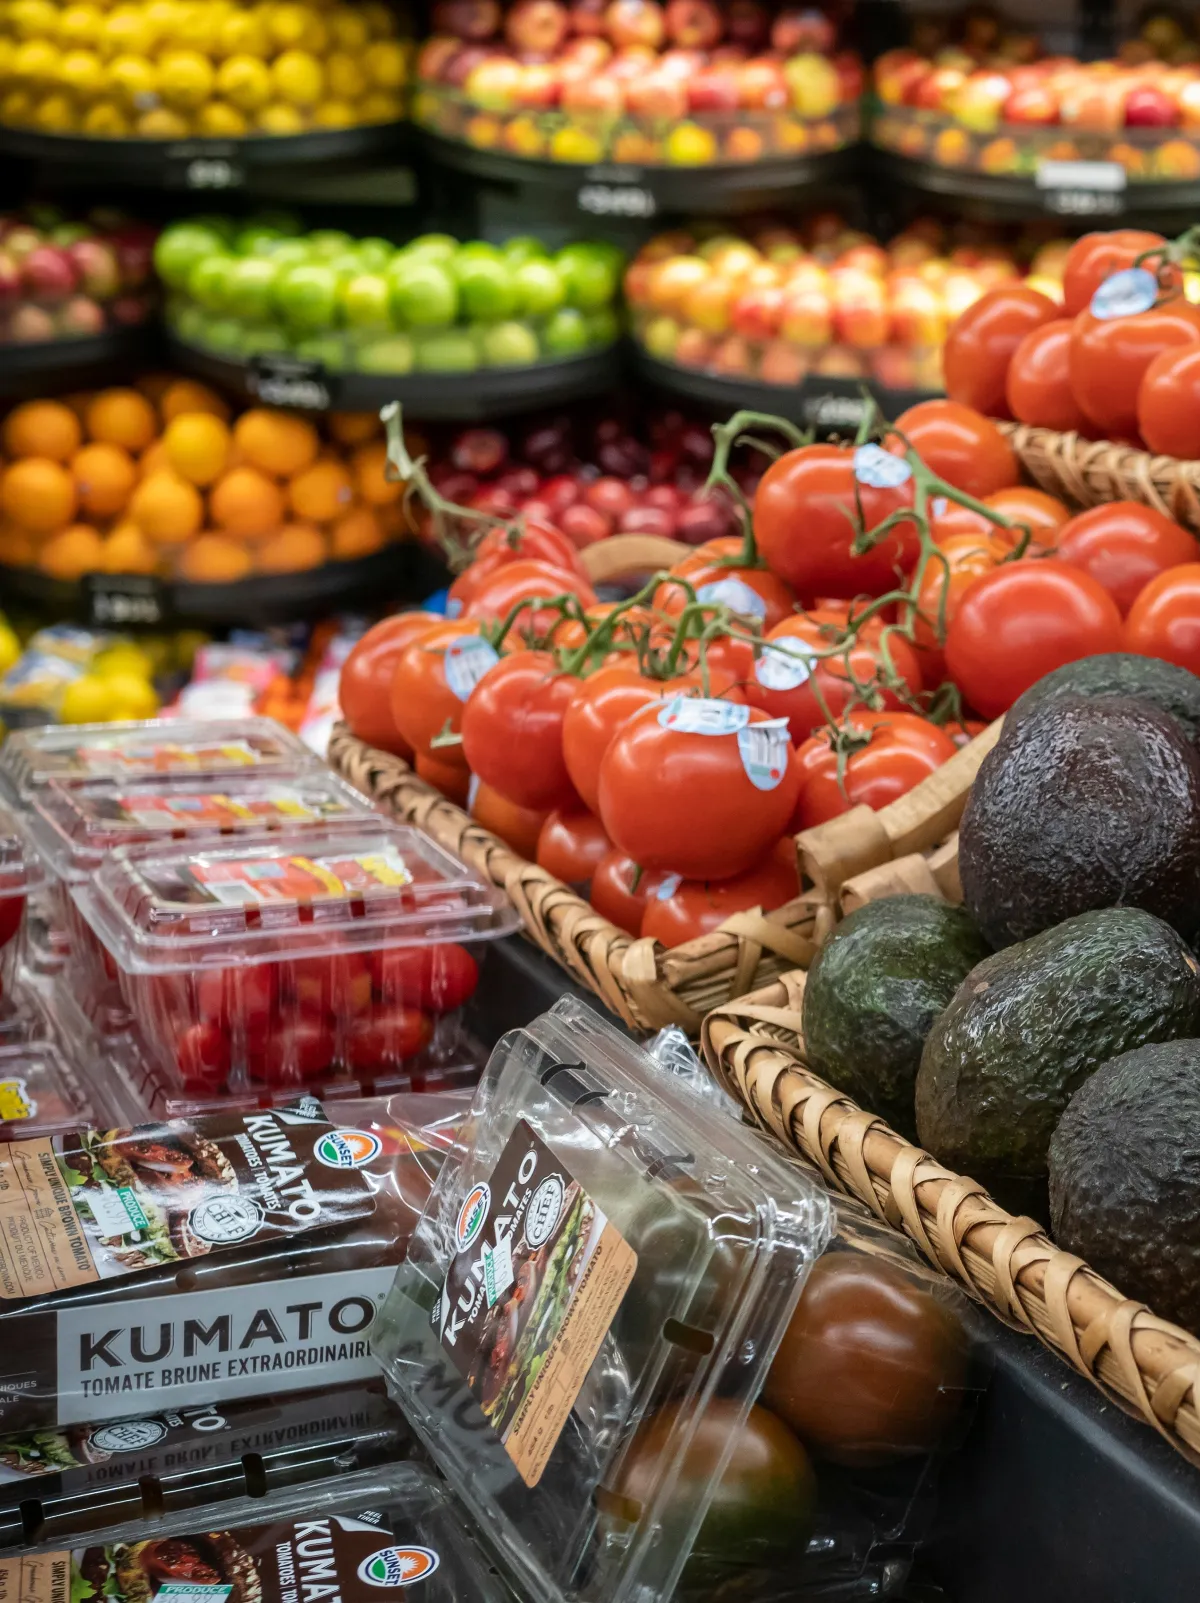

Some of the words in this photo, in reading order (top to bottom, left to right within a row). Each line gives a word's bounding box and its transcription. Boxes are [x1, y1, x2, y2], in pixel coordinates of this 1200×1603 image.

[38, 1152, 60, 1181] SIMPLY
[243, 1115, 321, 1220] KUMATO
[326, 1133, 353, 1166] SUNSET
[234, 1133, 263, 1167] TOMATOES
[254, 1172, 282, 1210] TOMATES
[49, 1177, 68, 1204] UNIQUE
[120, 1191, 146, 1227] PRODUCE
[58, 1204, 79, 1237] BROWN
[460, 1189, 490, 1250] SUNSET
[534, 1185, 555, 1241] CHEF
[30, 1251, 46, 1279] MEXICO
[69, 1236, 91, 1272] TOMATO
[444, 1149, 538, 1347] KUMATO
[80, 1297, 375, 1372] KUMATO
[513, 1391, 537, 1437] SIMPLY
[533, 1346, 558, 1392] UNIQUE
[556, 1298, 581, 1345] BROWN
[576, 1245, 603, 1294] TOMATO
[81, 1373, 155, 1399] TOMATE
[161, 1362, 221, 1388] BRUNE
[108, 1427, 147, 1445] CHEF
[52, 1561, 66, 1586] SIMPLY
[276, 1541, 296, 1585] TOMATOES
[293, 1519, 342, 1603] KUMA
[379, 1549, 401, 1587] SUNSET
